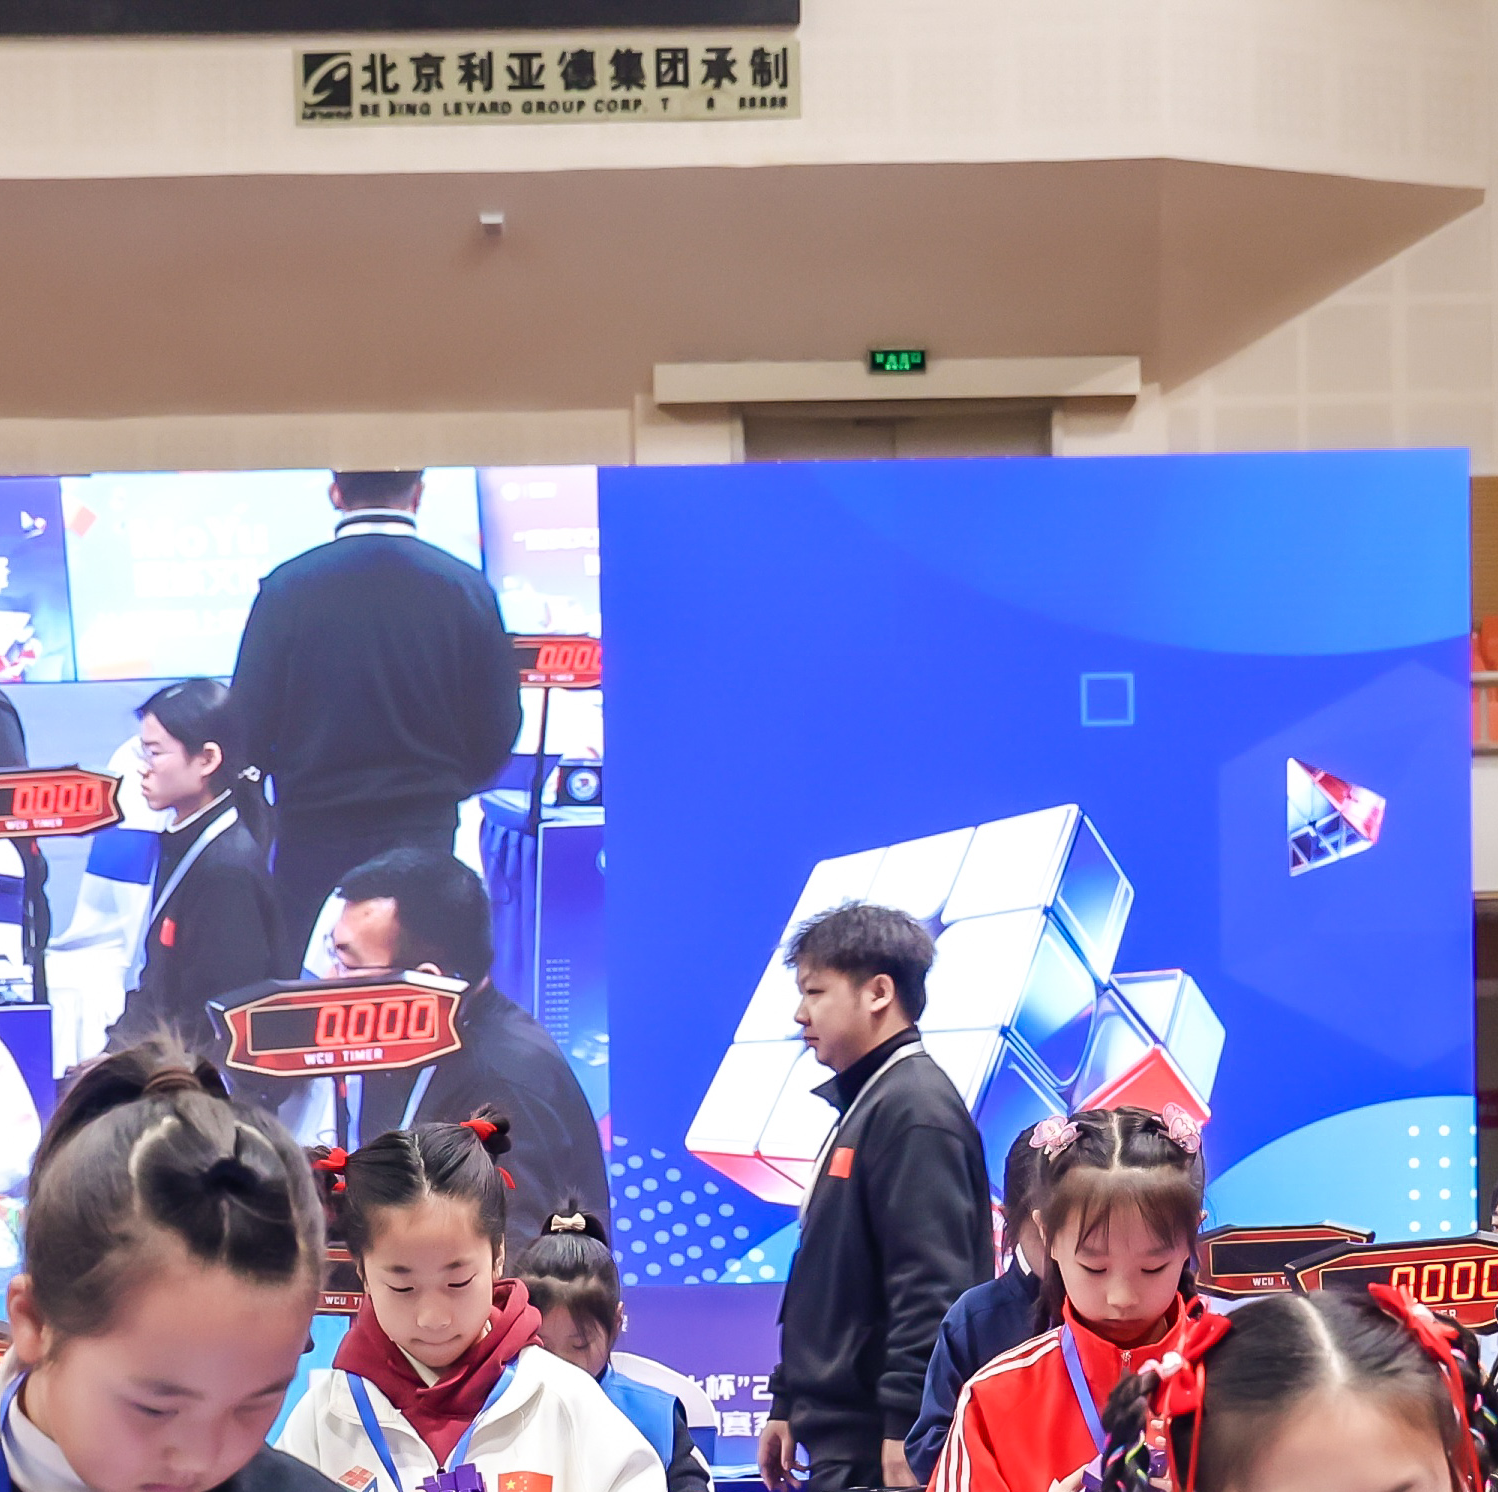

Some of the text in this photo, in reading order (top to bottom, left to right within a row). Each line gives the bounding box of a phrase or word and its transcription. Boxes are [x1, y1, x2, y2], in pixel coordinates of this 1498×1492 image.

[361, 48, 788, 94] 北京利亚德集团承制
